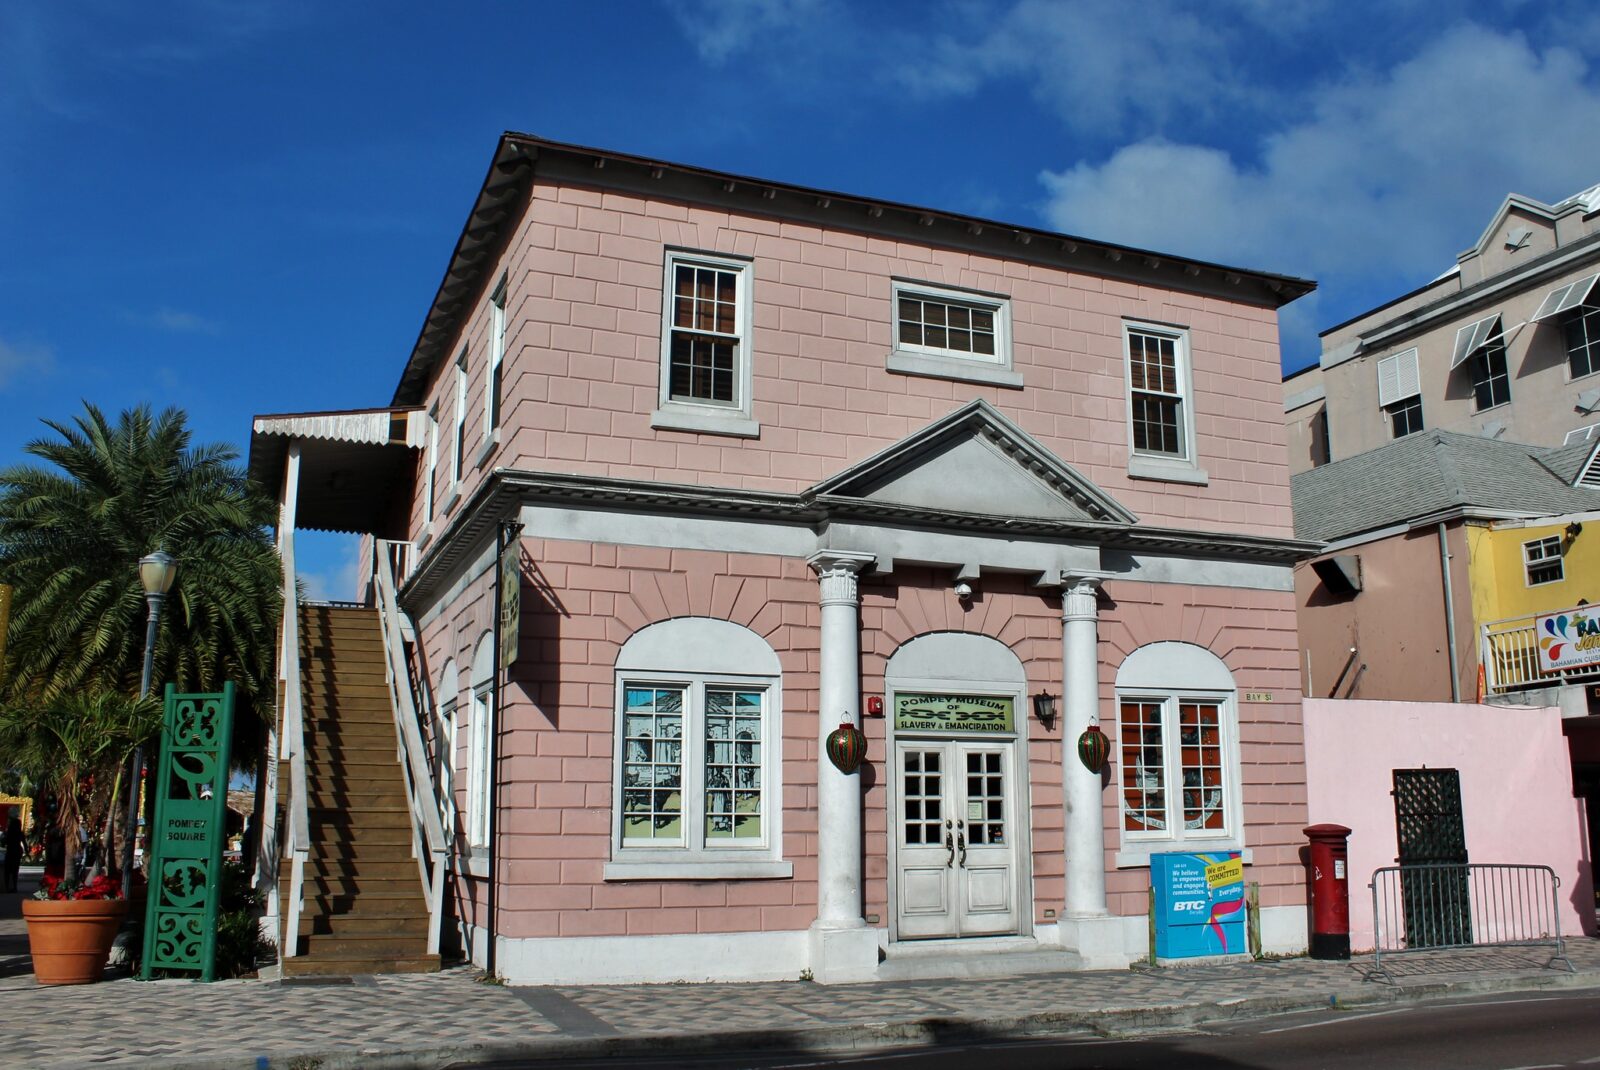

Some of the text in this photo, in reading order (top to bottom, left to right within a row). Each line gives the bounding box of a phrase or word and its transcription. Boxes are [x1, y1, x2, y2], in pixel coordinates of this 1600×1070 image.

[1551, 658, 1582, 668] BAHAMIAN
[1246, 693, 1261, 701] BAY
[901, 696, 1005, 710] POMPEY MUSEUM
[901, 721, 936, 729] SLAVERY
[945, 722, 1006, 731] EMANCIPATION
[168, 819, 207, 828] POMPEY
[168, 832, 206, 841] SQUARE
[1207, 867, 1216, 875] We
[1208, 868, 1240, 882] COMMITTED
[1218, 887, 1242, 896] Everyday.
[1173, 900, 1206, 911] BTC
